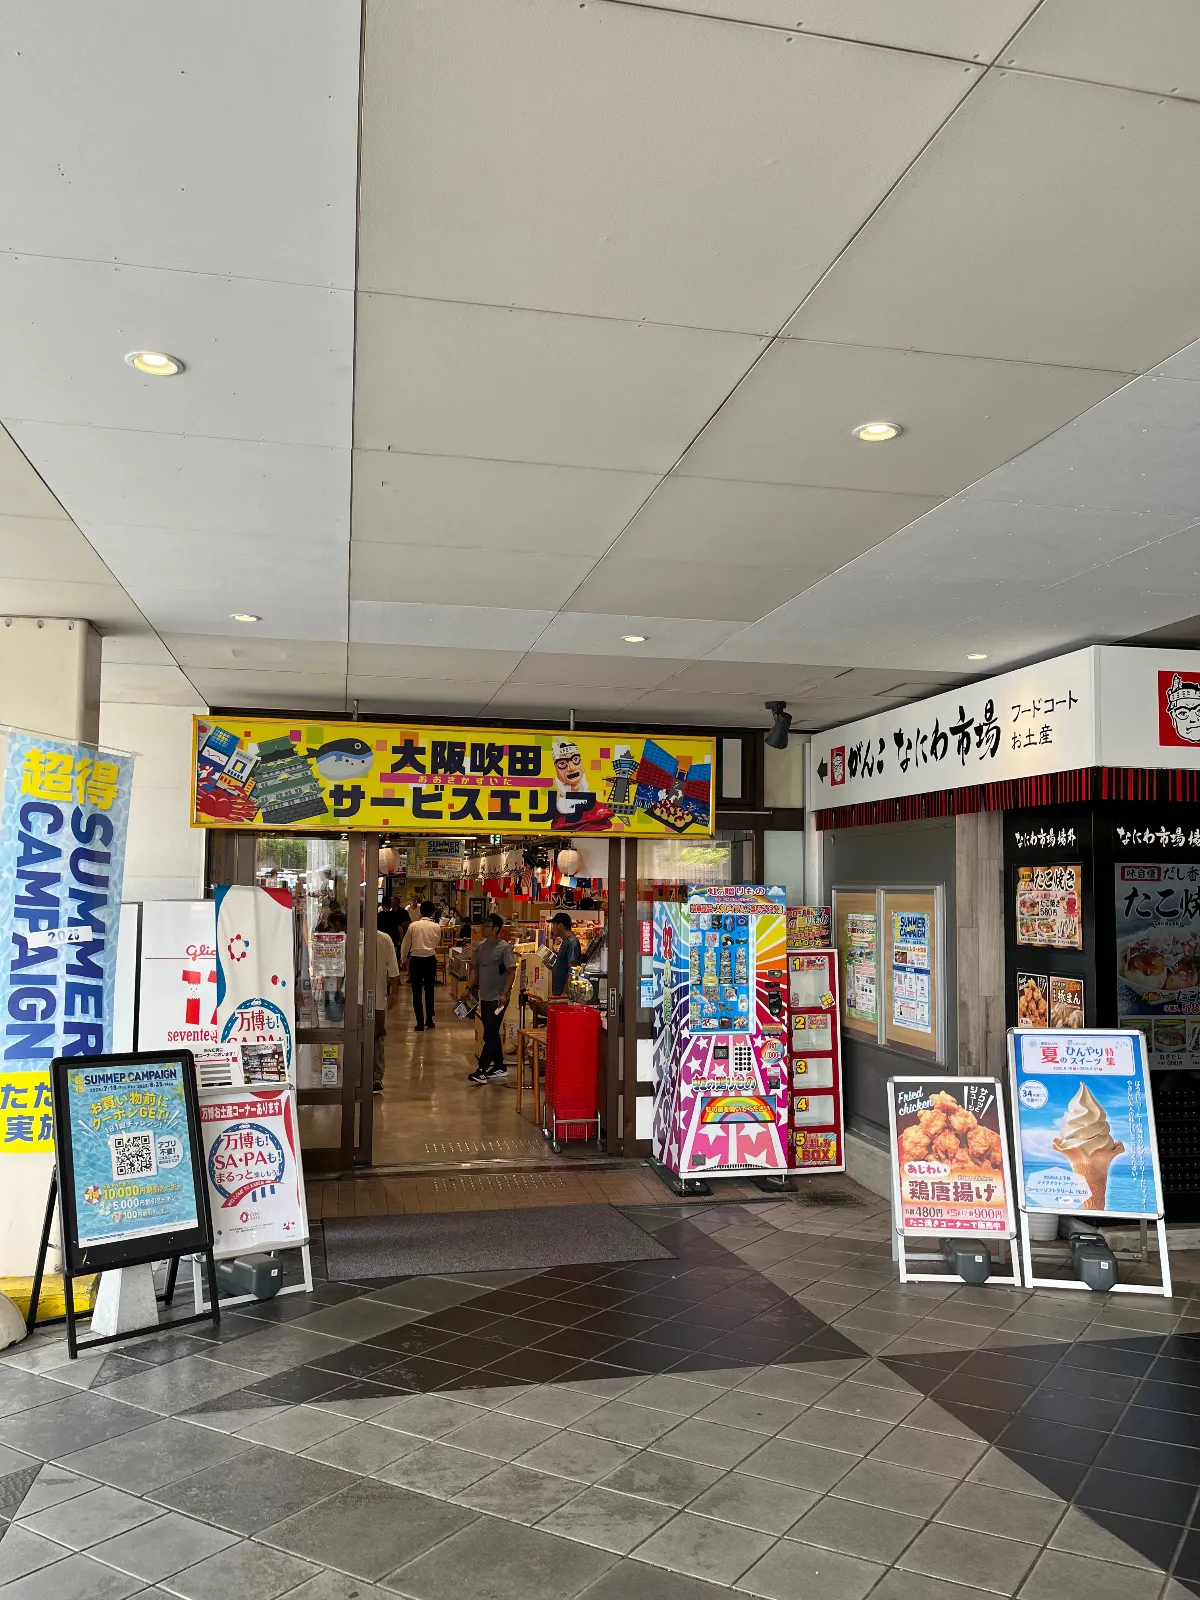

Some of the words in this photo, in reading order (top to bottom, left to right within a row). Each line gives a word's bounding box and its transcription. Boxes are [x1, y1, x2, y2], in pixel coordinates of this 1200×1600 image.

[1011, 690, 1079, 722] フードコート
[847, 737, 885, 778] がんこ
[894, 698, 1001, 773] なにわ市場
[1011, 723, 1053, 749] お土産
[390, 739, 542, 777] 大阪吹田
[21, 748, 120, 810] 超得
[418, 775, 512, 786] おおさかすいた
[329, 784, 597, 823] サービスエリア
[428, 840, 460, 848] SUMMER
[1015, 827, 1055, 848] なにわ市場
[1116, 826, 1186, 848] なにわ市場
[1034, 868, 1075, 890] たこ焼き
[1126, 868, 1157, 880] 味自慢
[706, 886, 766, 896] 虹の贈りもの
[4, 801, 64, 1060] CAMPAIGN
[47, 928, 80, 943] 2025
[62, 806, 114, 1058] SUMMER
[793, 957, 801, 971] 1
[237, 1010, 280, 1032] 万博も!
[794, 1015, 805, 1030] 2
[1066, 1047, 1103, 1057] ひんやり
[1104, 1047, 1116, 1066] 特集
[796, 1059, 806, 1074] 3
[84, 1072, 126, 1085] SUMMER
[128, 1069, 177, 1081] CAMPAIGN
[692, 1075, 757, 1092] 虹の贈りもの
[90, 1091, 169, 1115] お買い物前に
[898, 1086, 924, 1103] Fried
[201, 1101, 280, 1120] 万博お土産コーナーあります
[797, 1097, 807, 1112] 4
[899, 1099, 934, 1116] chicken
[91, 1107, 170, 1131] クーポンGET!
[158, 1140, 176, 1149] アプリ
[222, 1132, 269, 1151] 万博も!
[795, 1132, 806, 1146] 5
[802, 1149, 829, 1161] BOX
[907, 1163, 949, 1174] あじわい
[908, 1180, 998, 1203] 鶏唐揚げ
[909, 1218, 1002, 1231] たこ焼きコーナーで販売中
